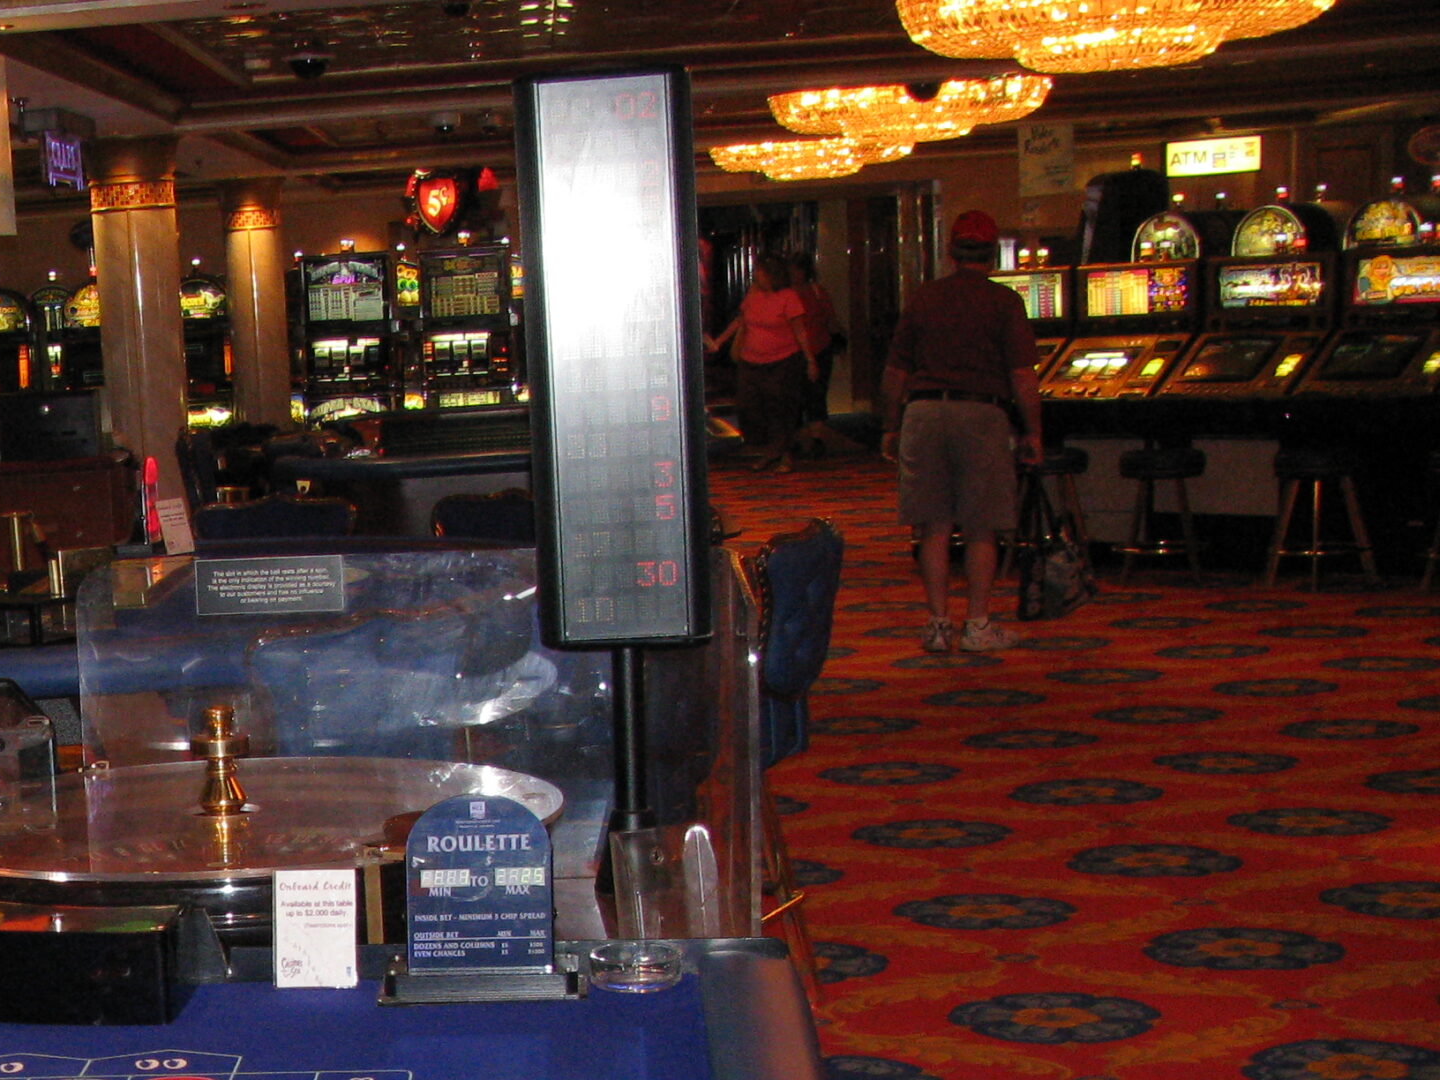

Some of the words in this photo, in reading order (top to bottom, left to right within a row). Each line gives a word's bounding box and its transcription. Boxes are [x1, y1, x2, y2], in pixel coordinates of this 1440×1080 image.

[1170, 151, 1207, 168] ATM
[636, 560, 679, 587] 30
[426, 833, 532, 853] ROULETTE
[279, 881, 319, 891] Onboard
[323, 881, 352, 891] Credit
[470, 875, 489, 887] TO
[429, 887, 452, 897] MIN
[505, 885, 531, 896] MAX
[458, 913, 493, 921] MINIMUM
[519, 911, 546, 920] SPREAD
[413, 942, 442, 950] DOZENS
[443, 942, 459, 950] AND
[460, 941, 496, 949] COLUMNS
[414, 950, 432, 958] EVEN
[432, 949, 466, 957] CHANCES
[0, 1062, 24, 1074] 0
[135, 1058, 188, 1070] 00
